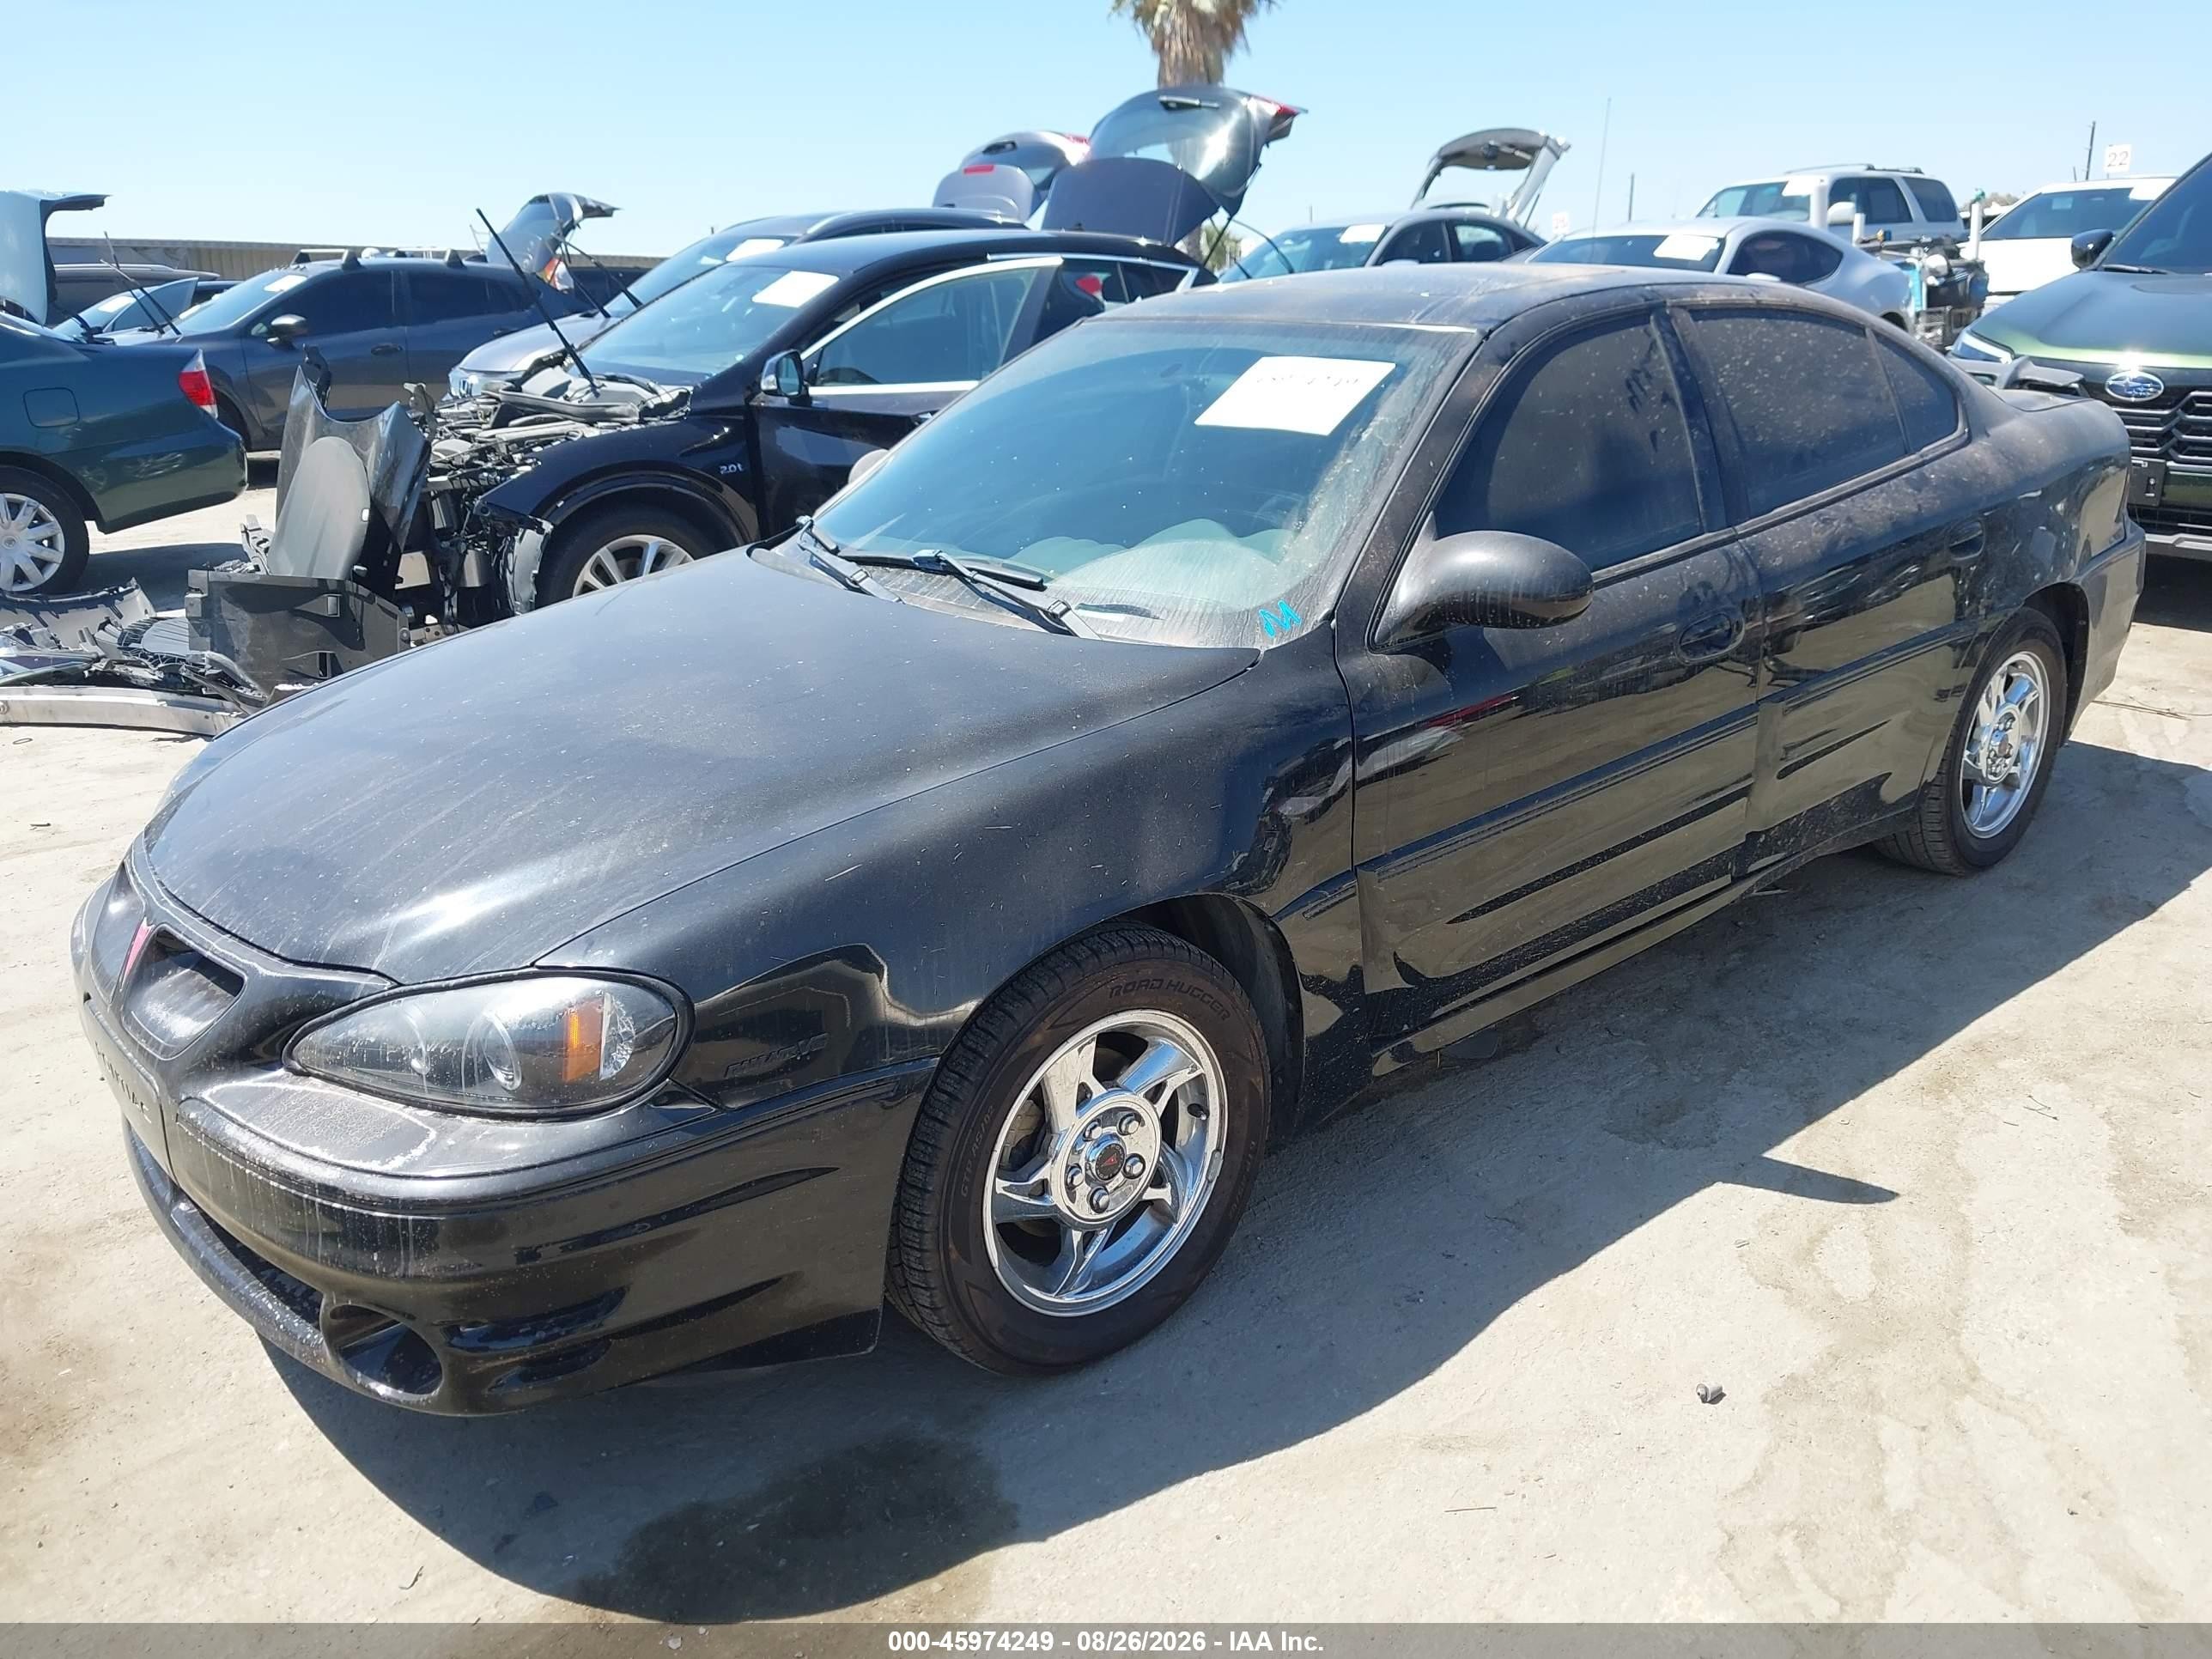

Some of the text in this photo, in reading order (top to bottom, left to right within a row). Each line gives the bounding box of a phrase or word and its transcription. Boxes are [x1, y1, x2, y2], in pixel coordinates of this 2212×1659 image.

[2107, 151, 2129, 167] 22
[1108, 978, 1231, 1021] ROAD HUGGER
